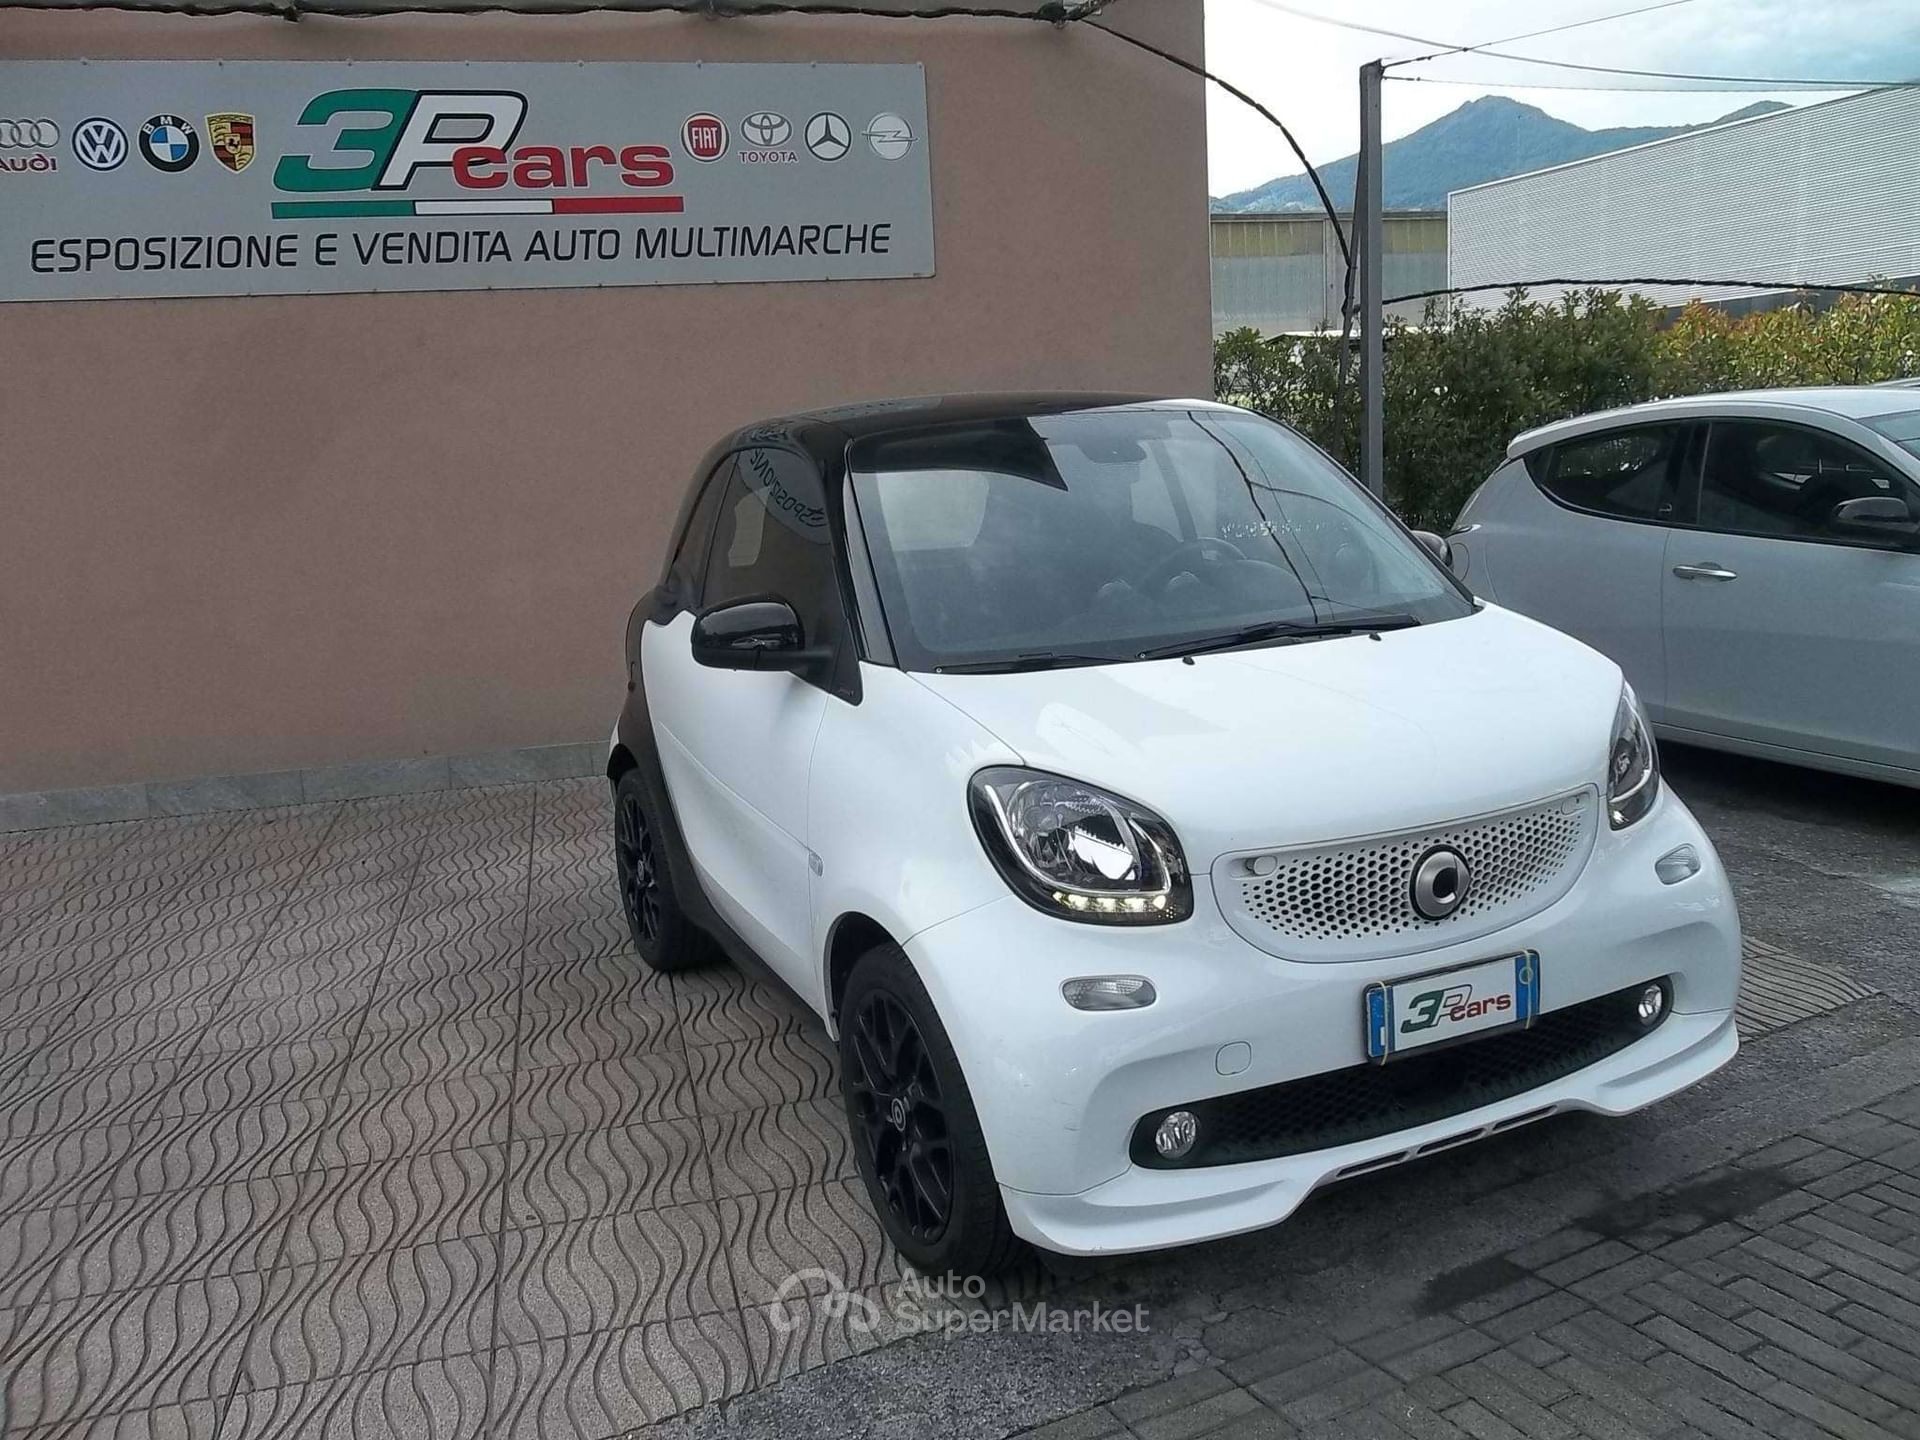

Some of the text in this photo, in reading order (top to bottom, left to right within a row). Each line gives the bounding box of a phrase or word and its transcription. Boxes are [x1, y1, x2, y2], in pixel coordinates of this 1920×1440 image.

[142, 115, 194, 135] BMW
[691, 126, 719, 149] FIAT
[739, 151, 798, 163] TOYOTA
[31, 223, 892, 273] ESPOSIZIONE E VENDITA AUTO MULTIMARCHE
